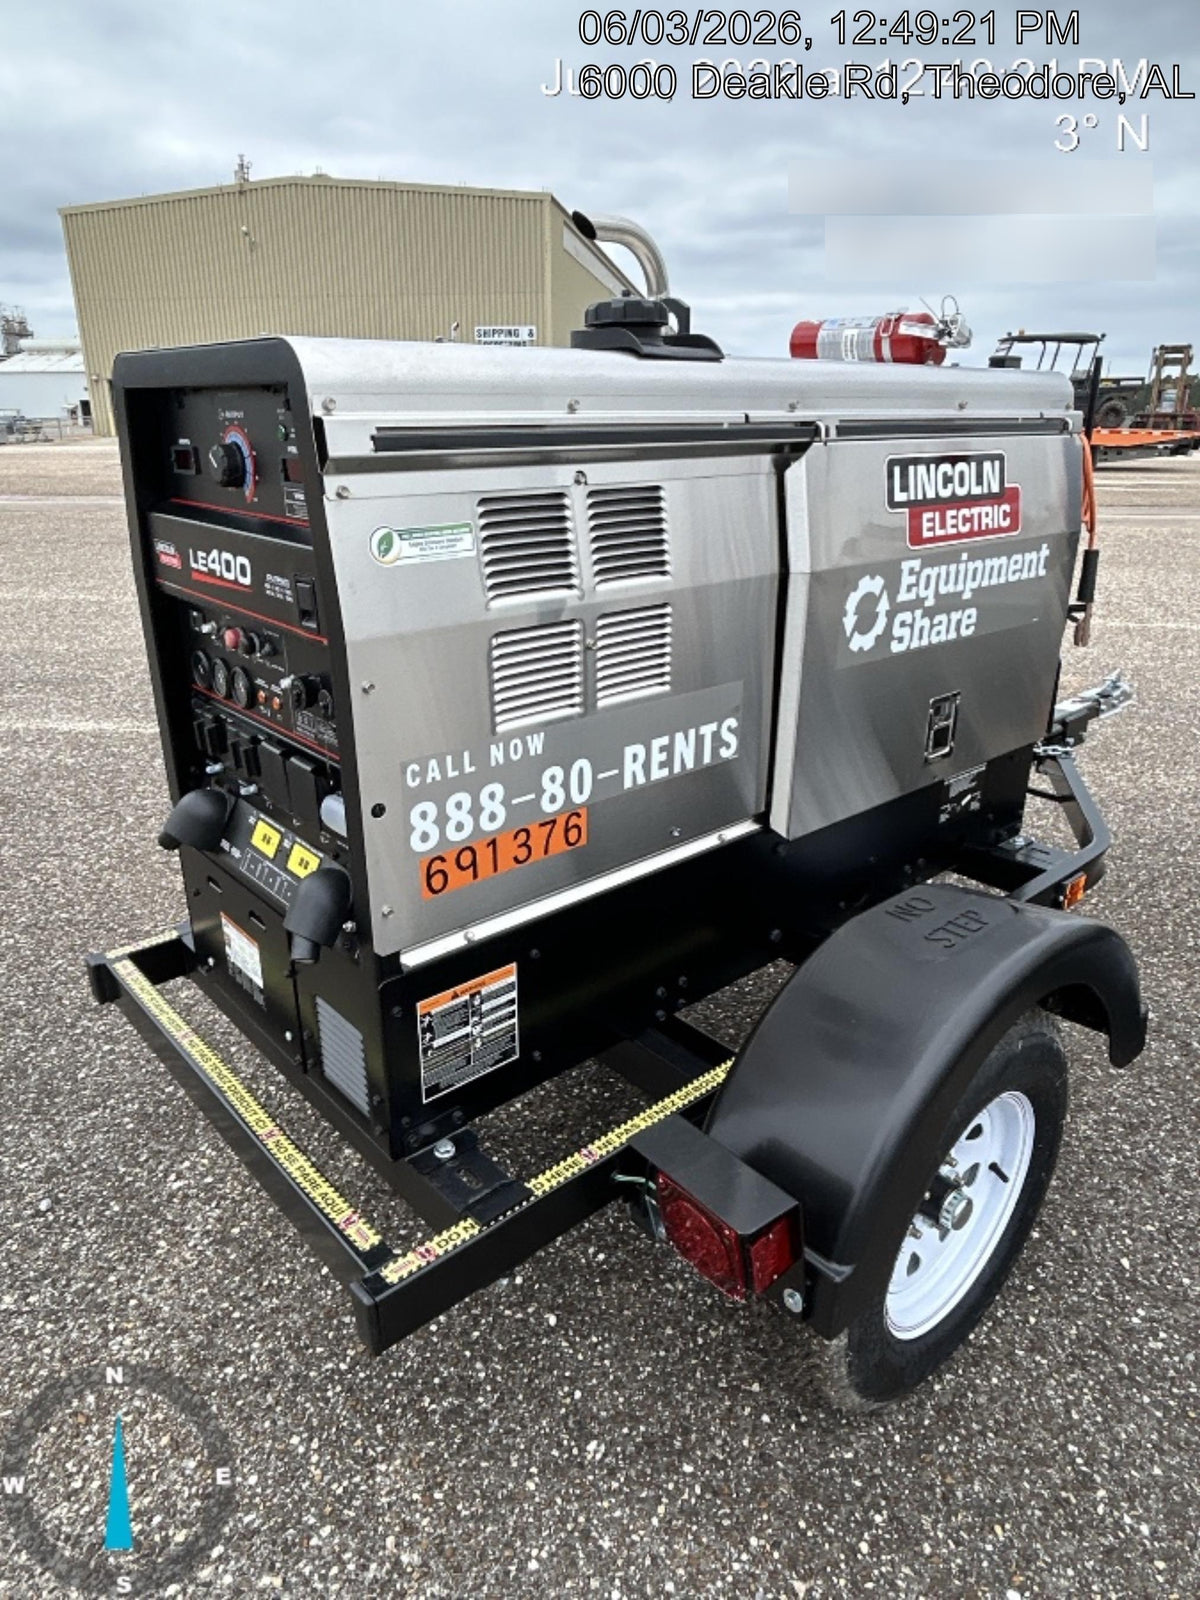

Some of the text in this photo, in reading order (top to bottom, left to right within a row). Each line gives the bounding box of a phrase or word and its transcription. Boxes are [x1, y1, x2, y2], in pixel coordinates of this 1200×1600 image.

[476, 328, 535, 338] SHIPPING &
[892, 460, 1001, 503] LINCOLN
[921, 503, 1012, 540] ELECTRIC
[188, 547, 252, 586] LE400
[895, 543, 1051, 608] Equipment
[889, 606, 979, 654] Share
[405, 731, 546, 788] CALL NOW
[408, 717, 740, 853] 888-80-RENTS
[424, 810, 584, 897] 691376
[885, 896, 990, 949] NO STEP
[295, 1164, 322, 1192] PARE
[547, 1157, 585, 1184] HERE
[436, 1231, 461, 1249] DO
